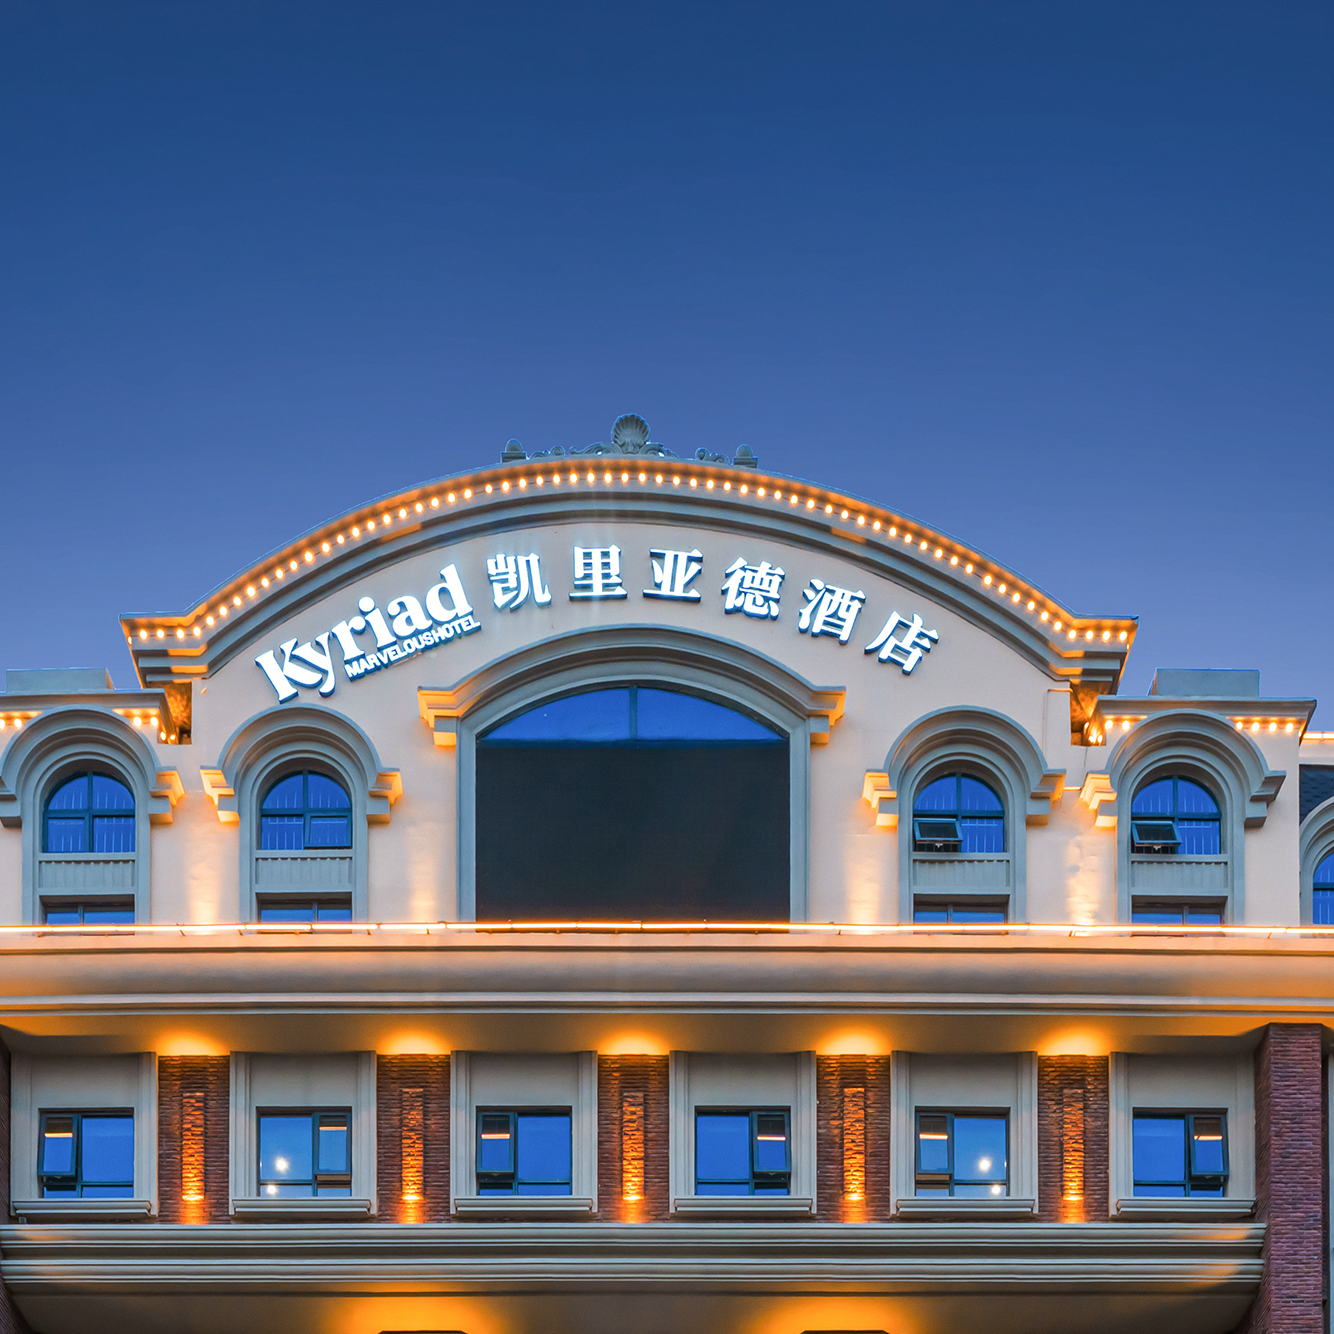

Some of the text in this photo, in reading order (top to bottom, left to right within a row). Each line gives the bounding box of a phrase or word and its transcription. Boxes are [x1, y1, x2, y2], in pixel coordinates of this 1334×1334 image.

[254, 544, 939, 704] Kyriad 凯里亚德酒店
